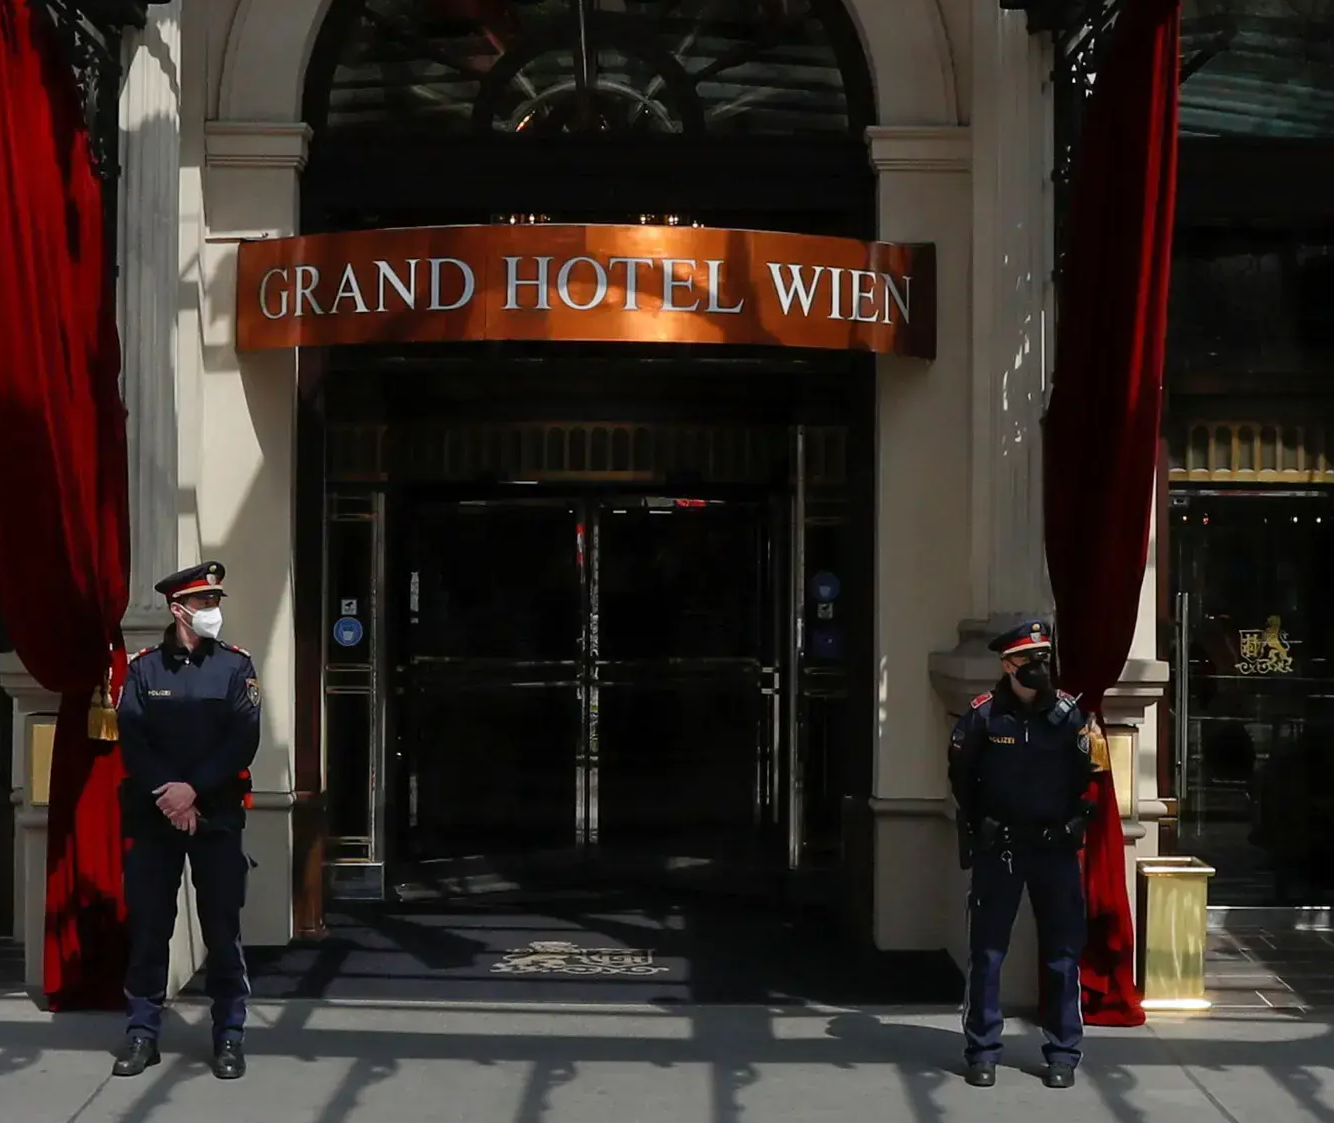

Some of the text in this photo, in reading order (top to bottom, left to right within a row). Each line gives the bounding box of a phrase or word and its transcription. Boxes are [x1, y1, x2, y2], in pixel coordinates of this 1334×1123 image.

[259, 255, 914, 325] GRAND HOTEL WIEN
